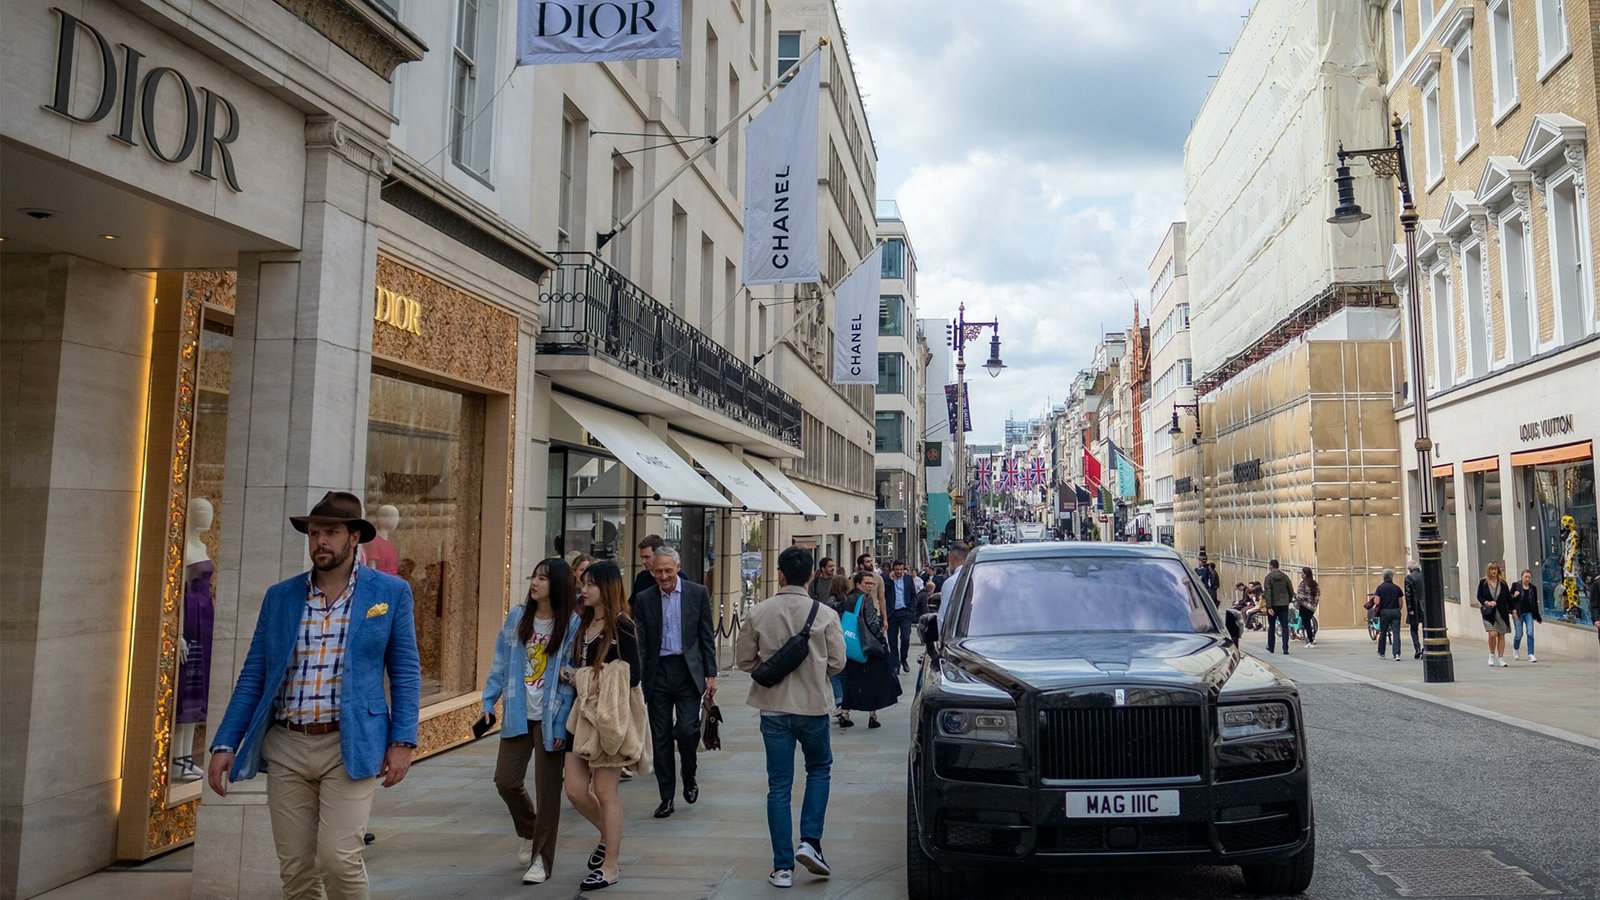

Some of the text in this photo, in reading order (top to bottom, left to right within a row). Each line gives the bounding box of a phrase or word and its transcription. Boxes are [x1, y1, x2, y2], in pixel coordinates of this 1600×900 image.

[534, 0, 658, 39] DIOR
[40, 7, 243, 192] DIOR
[772, 165, 790, 269] CHANEL
[375, 286, 421, 336] DIOR
[851, 313, 862, 376] CHANEL
[1519, 414, 1574, 441] LOUIS VUITTON
[1087, 795, 1125, 814] MAG
